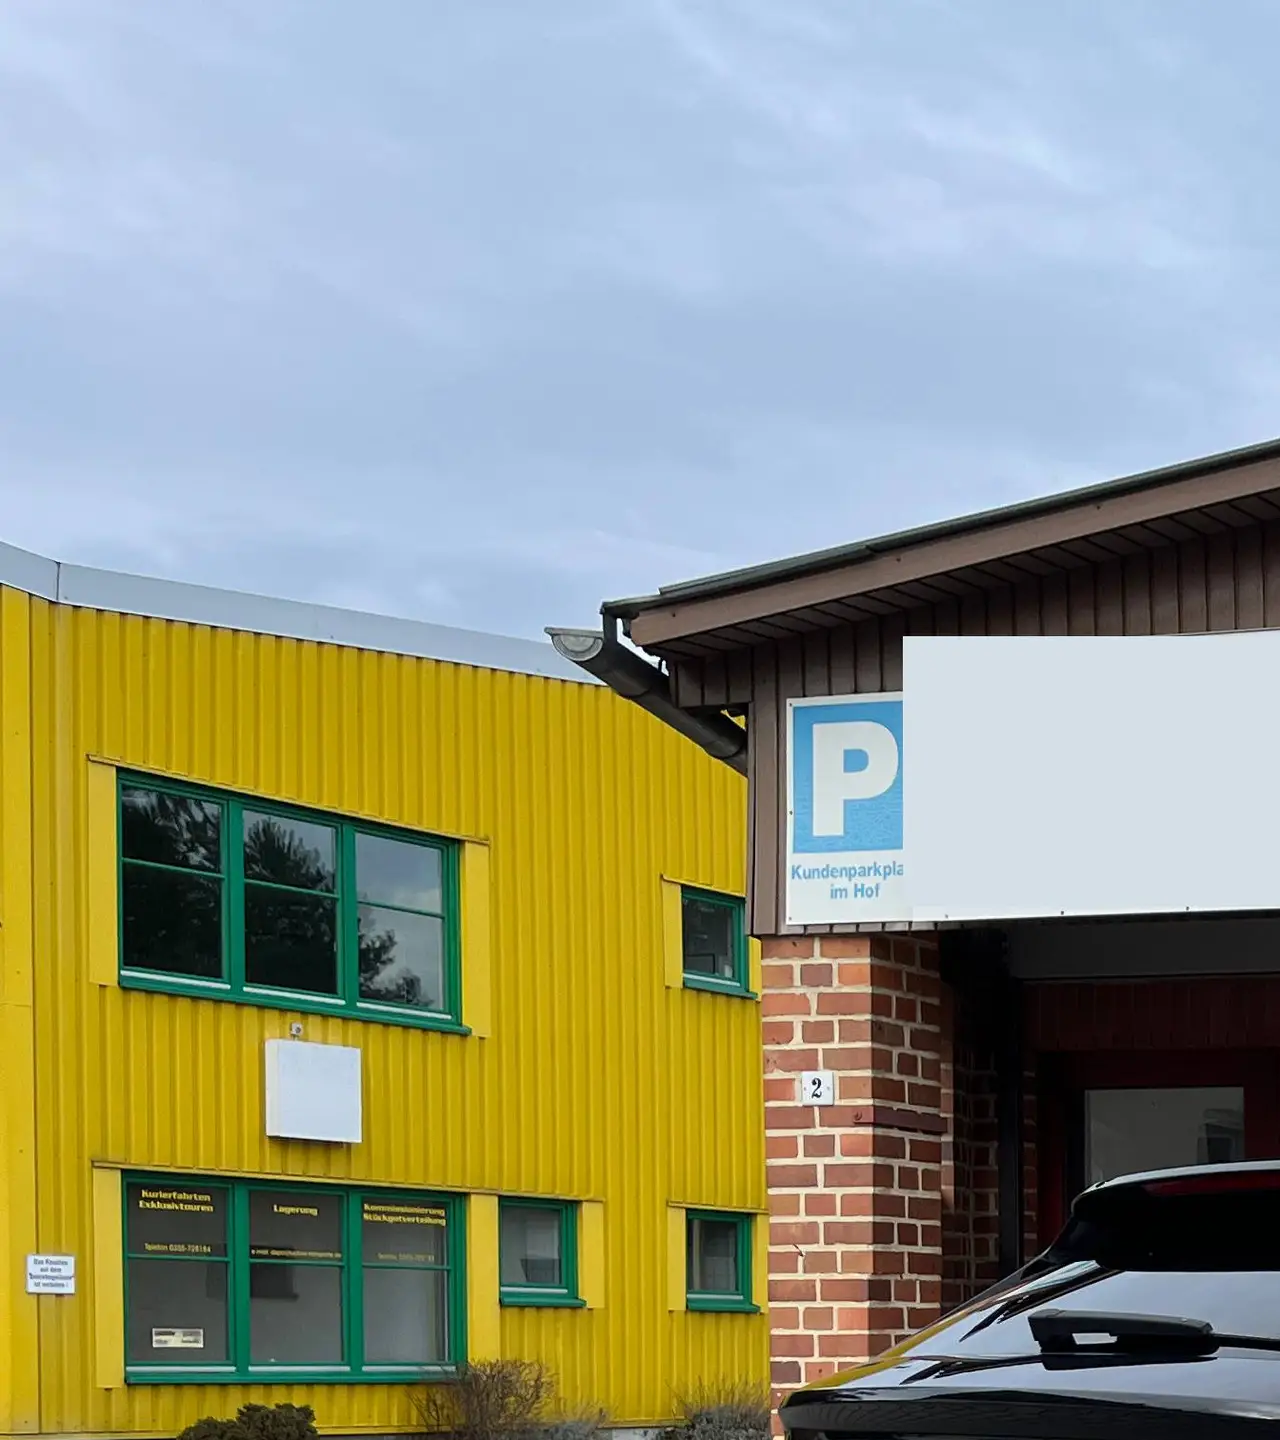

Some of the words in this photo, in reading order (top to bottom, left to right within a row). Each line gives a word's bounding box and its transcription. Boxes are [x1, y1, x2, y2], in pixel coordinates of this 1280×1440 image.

[812, 720, 900, 838] P
[830, 884, 848, 899] im
[854, 883, 880, 898] Hof
[811, 1077, 823, 1099] 2
[141, 1189, 212, 1202] Kurierfahrten
[139, 1200, 214, 1213] Exklusivtouren
[273, 1204, 318, 1217] Lagerung
